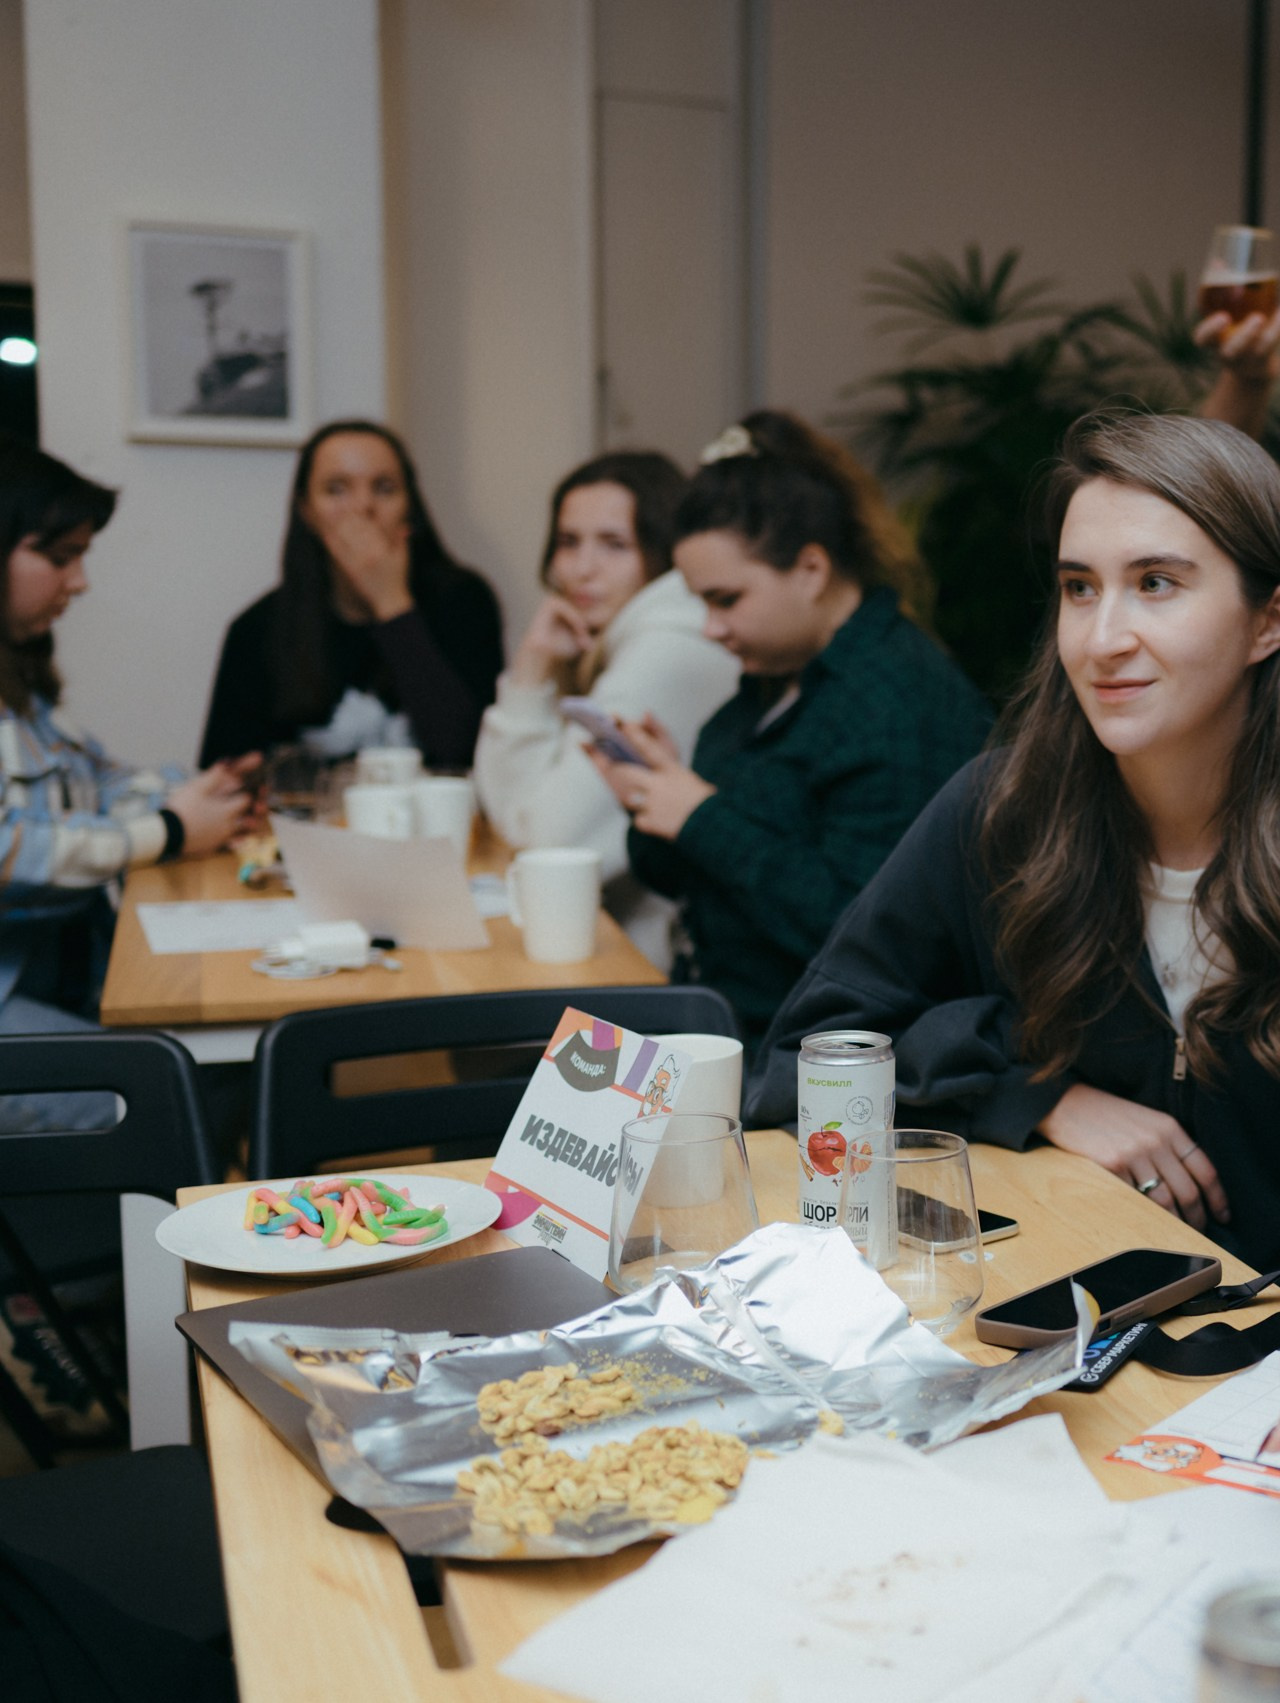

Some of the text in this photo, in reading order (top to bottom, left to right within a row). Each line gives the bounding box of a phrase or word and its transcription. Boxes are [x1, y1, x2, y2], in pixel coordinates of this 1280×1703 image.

[570, 1051, 607, 1078] КОМАНДА:
[807, 1077, 852, 1088] ВКУСВИЛЛ
[1090, 1356, 1113, 1374] СБЕР
